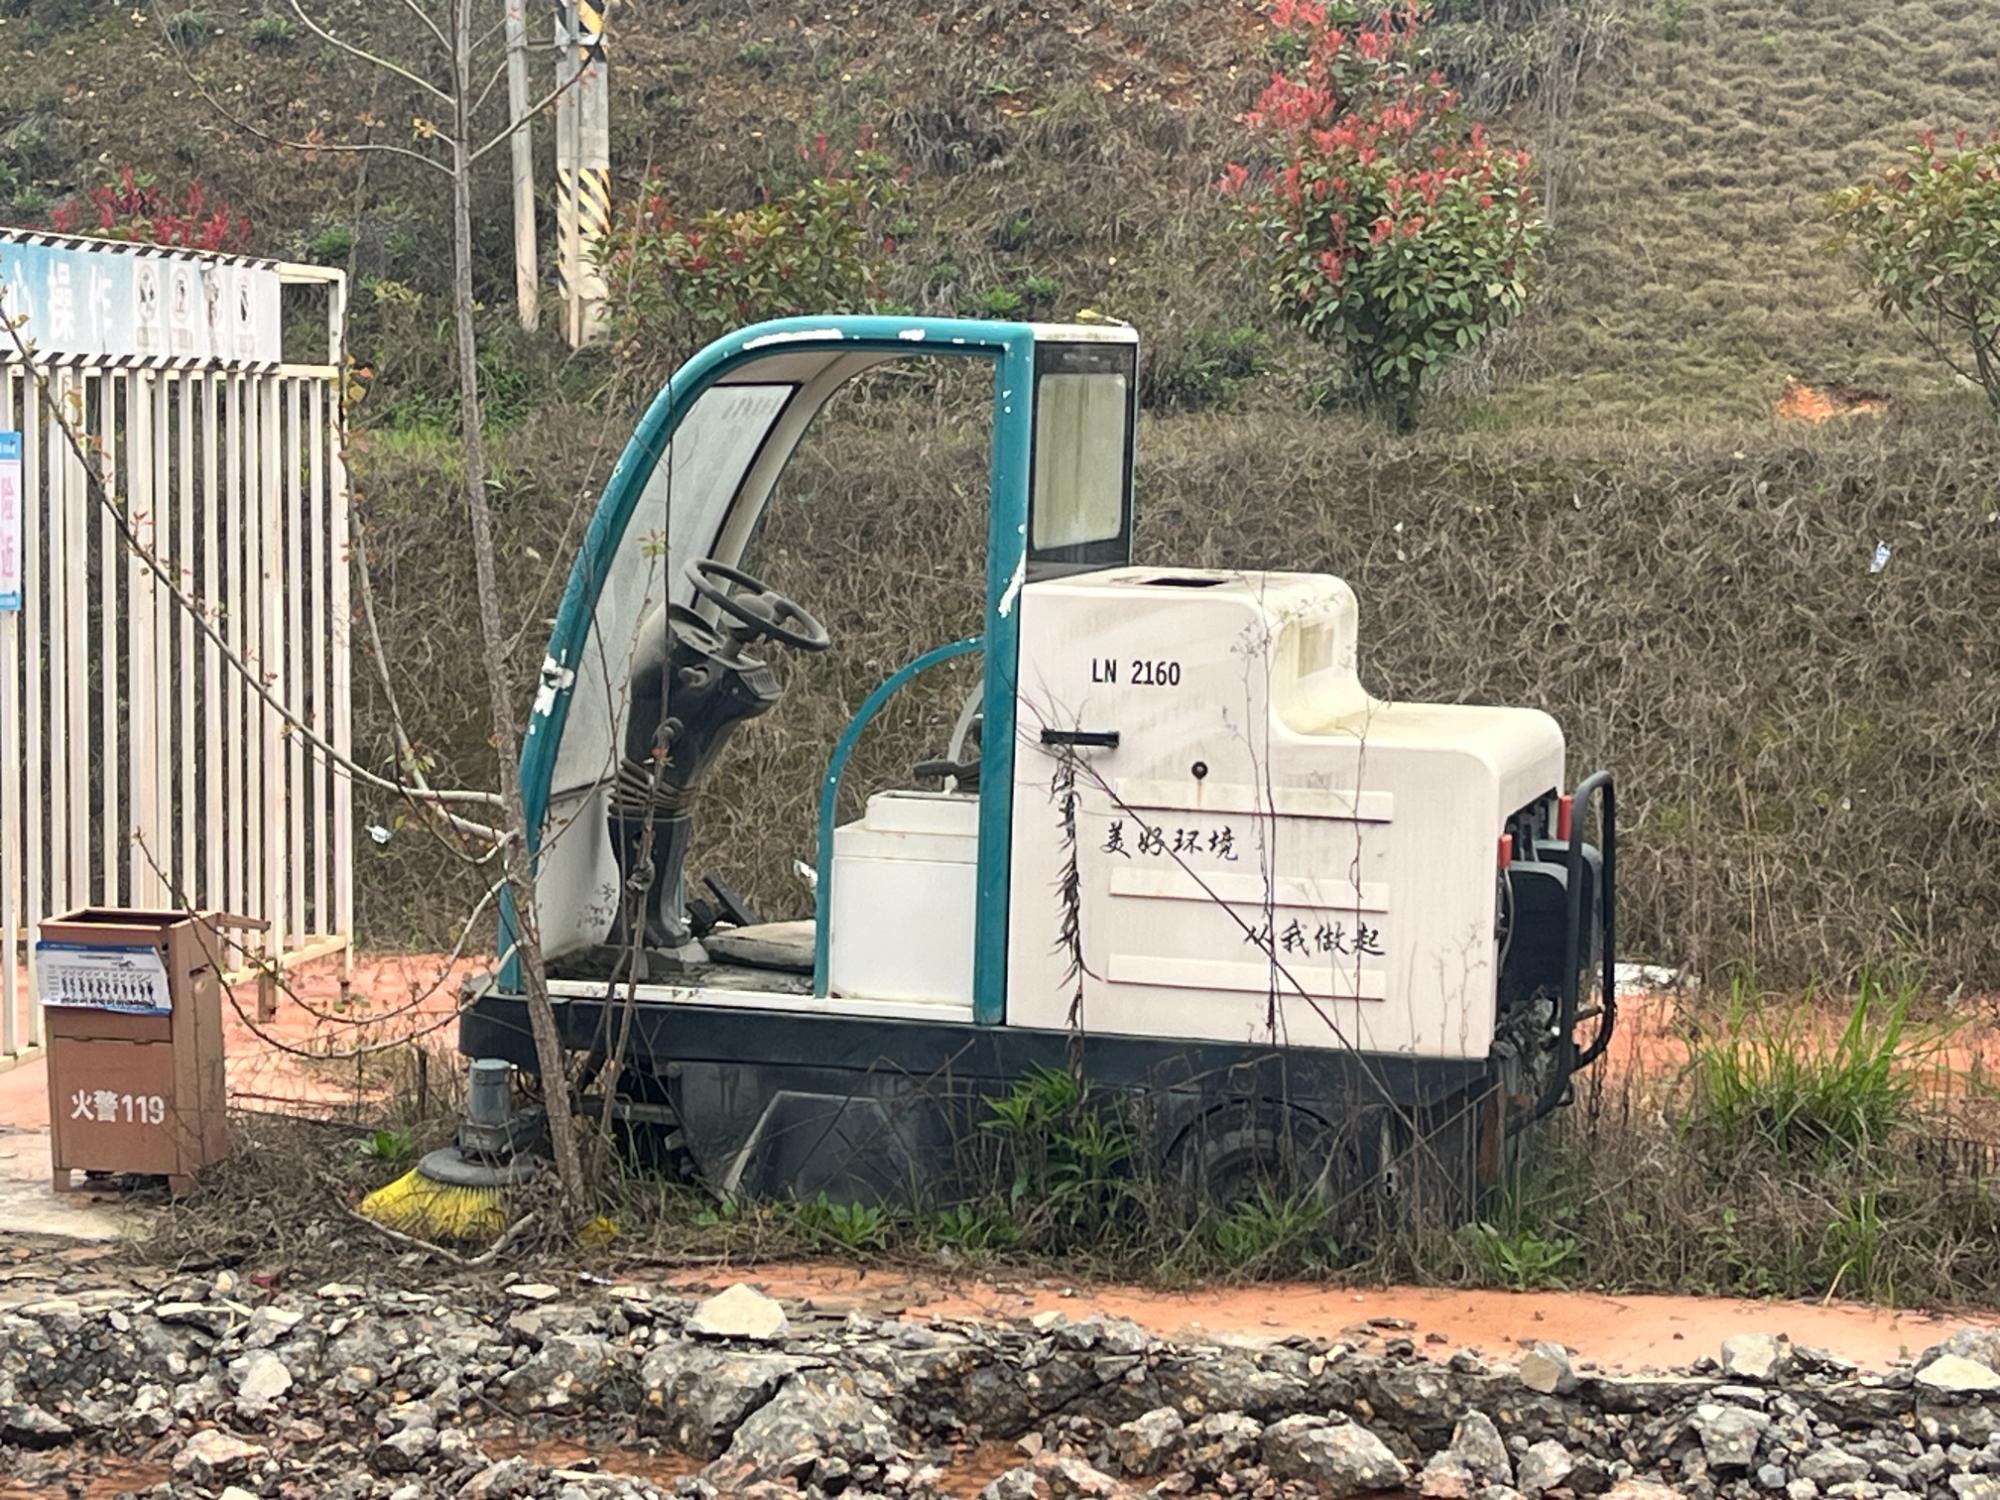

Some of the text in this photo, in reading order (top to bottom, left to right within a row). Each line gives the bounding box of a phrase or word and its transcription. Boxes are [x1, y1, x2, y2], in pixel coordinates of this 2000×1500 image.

[1091, 659, 1181, 686] LN 2160
[1100, 820, 1239, 861] 美好环境
[1244, 918, 1386, 957] 从我做起
[70, 1088, 165, 1125] 火警119
